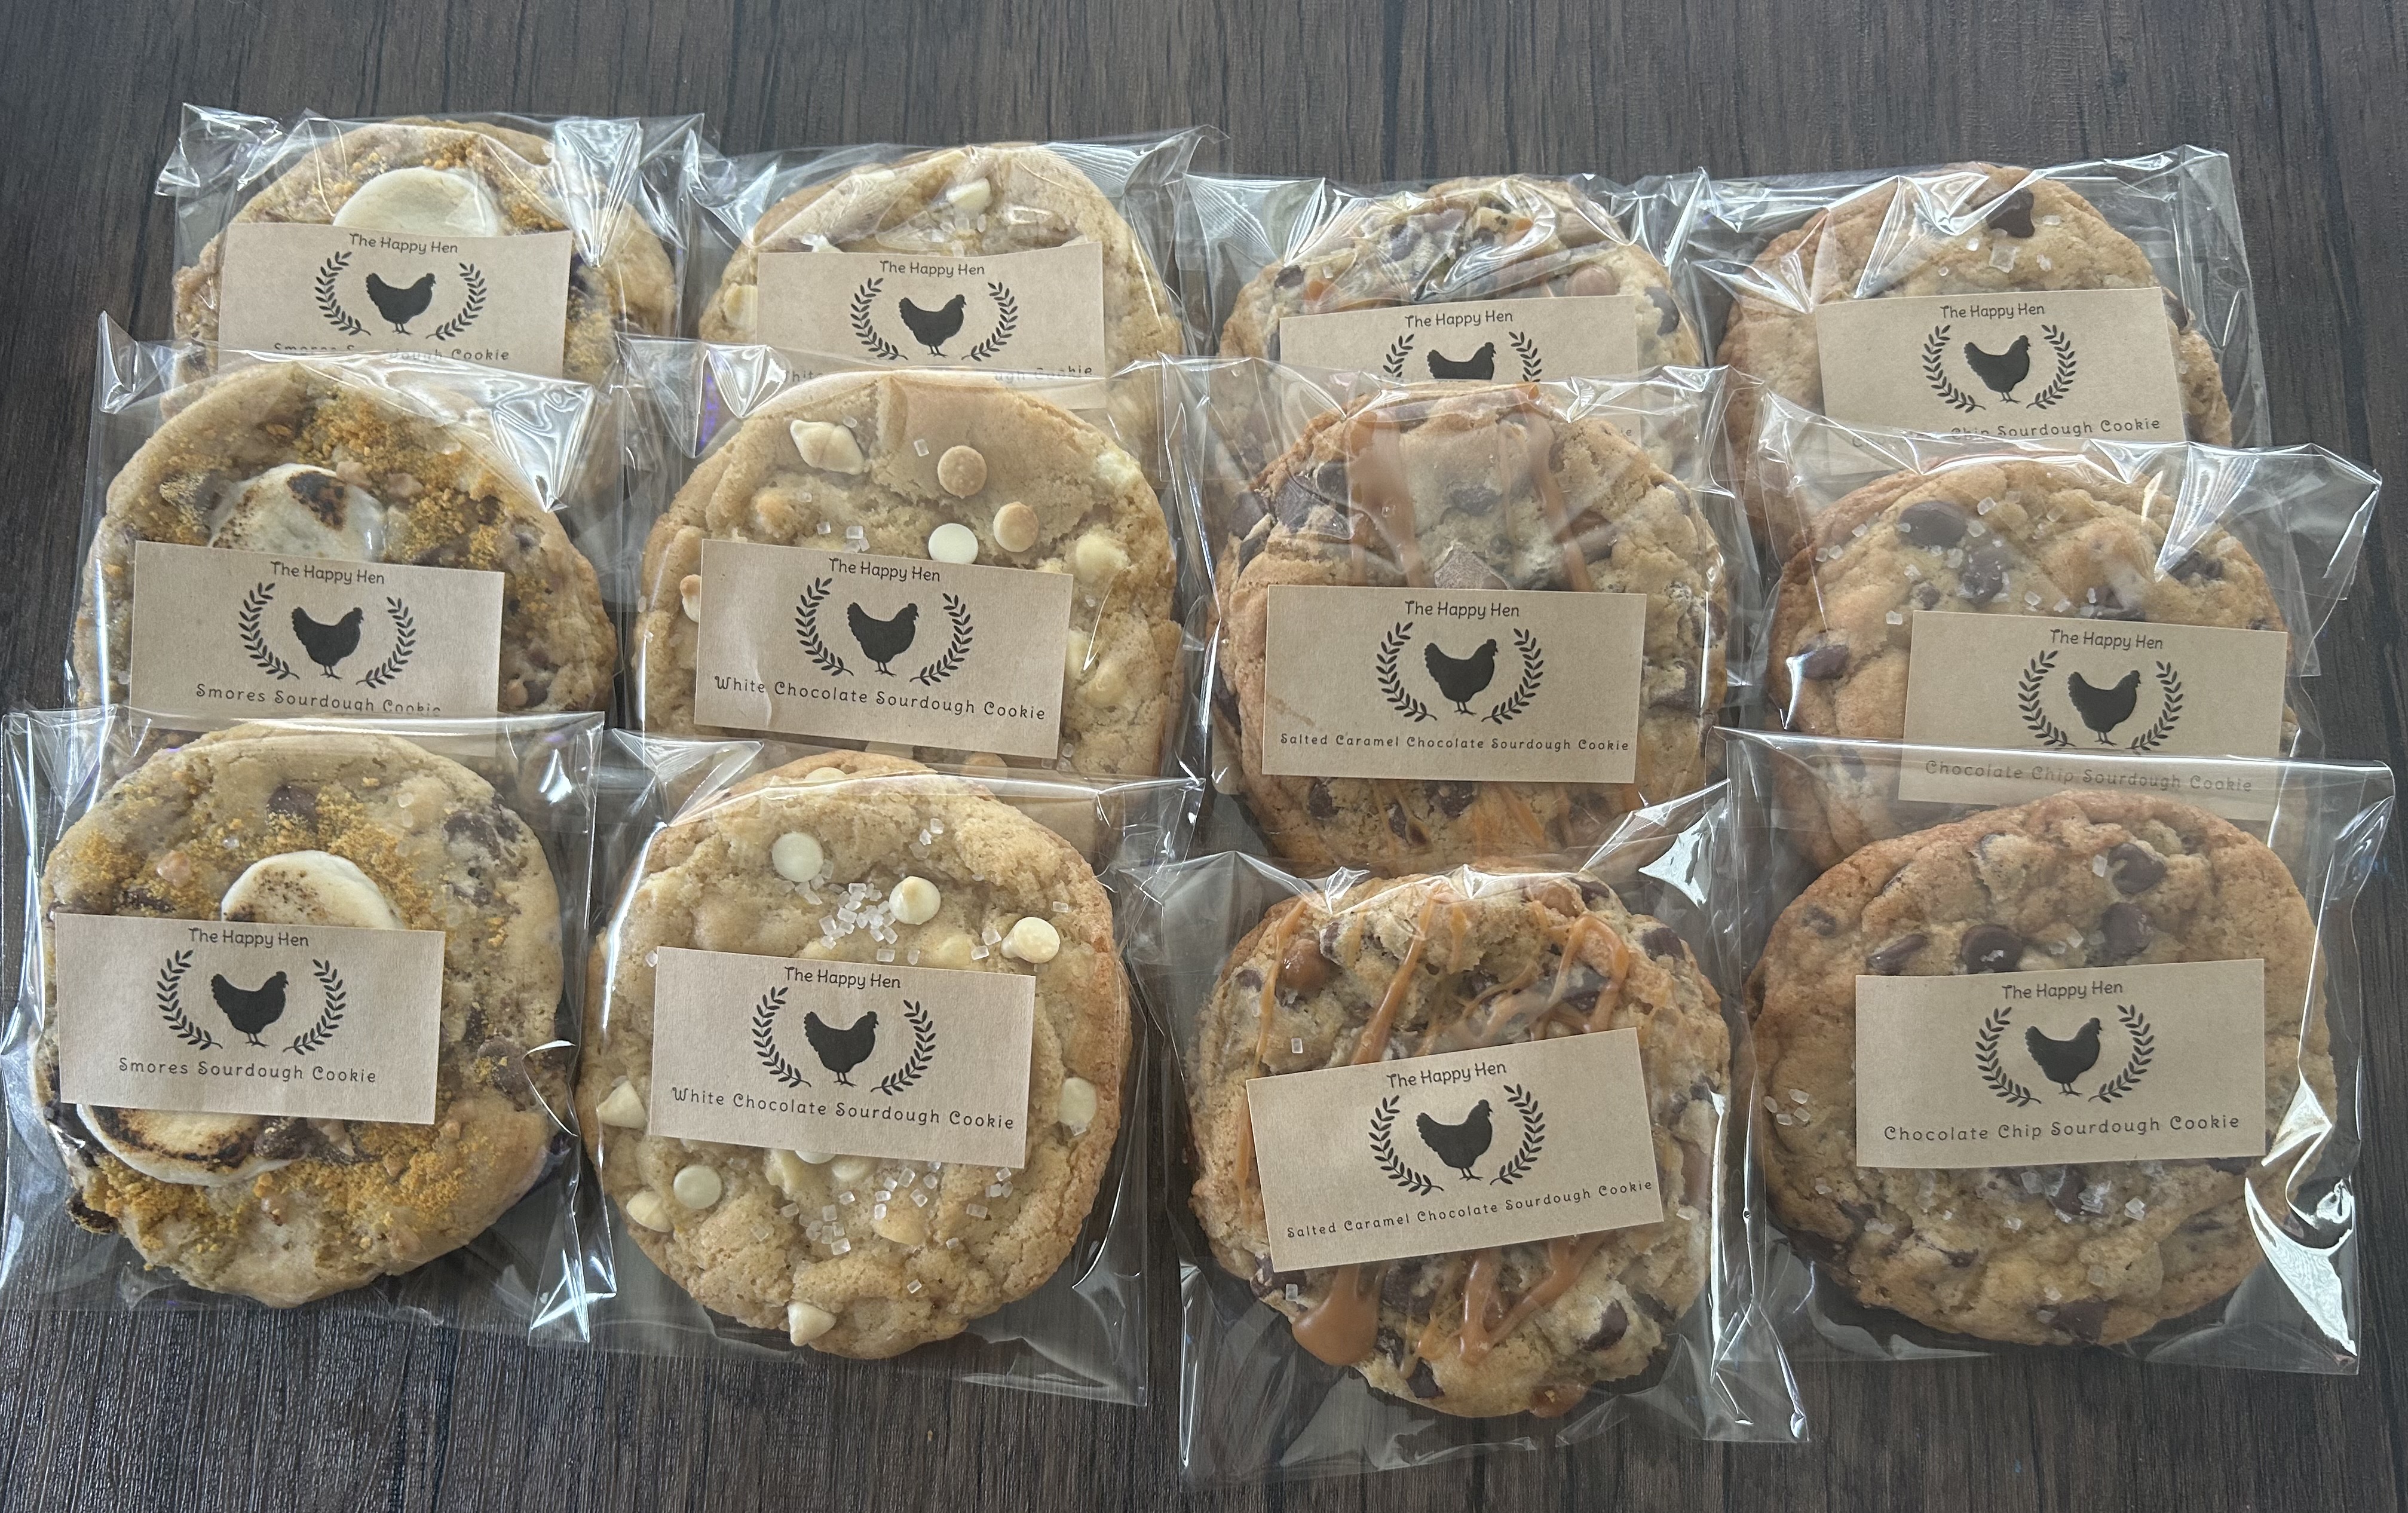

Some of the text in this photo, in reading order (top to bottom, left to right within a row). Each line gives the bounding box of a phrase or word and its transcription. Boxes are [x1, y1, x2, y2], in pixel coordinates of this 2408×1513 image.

[349, 232, 458, 255] The Happy Hen
[880, 260, 985, 278] The Happy Hen
[1404, 310, 1513, 328] The Happy Hen
[1940, 302, 2045, 320] The Happy Hen
[451, 348, 509, 361] Cookie
[1998, 421, 2093, 437] Sourdough
[2100, 418, 2160, 433] Cookie
[270, 561, 385, 586] The Happy Hen
[829, 558, 940, 583] The Happy Hen
[1405, 600, 1519, 620] The Happy Hen
[2049, 629, 2163, 651] The Happy Hen
[196, 683, 265, 702] Smores
[274, 690, 374, 712] Sourdough
[714, 675, 1045, 720] White Chocolate Sourdough Cookie
[1280, 733, 1628, 752] Salted Caramel Chocolate Sourdough Cookie
[1925, 760, 2252, 792] Chocolate Chip Sourdough Cookie
[188, 927, 309, 949] The Happy Hen
[784, 966, 900, 990] The Happy Hen
[2001, 980, 2123, 1000] The Happy Hen
[119, 1057, 376, 1083] Smores Sourdough Cookie
[1386, 1062, 1507, 1089] The Happy Hen
[672, 1087, 1013, 1129] White Chocolate Sourdough Cookie
[1884, 1114, 2239, 1141] Chocolate Chip Sourdough Cookie
[1287, 1181, 1652, 1238] Salted Caramel Chocolate Sourdough Cookie
